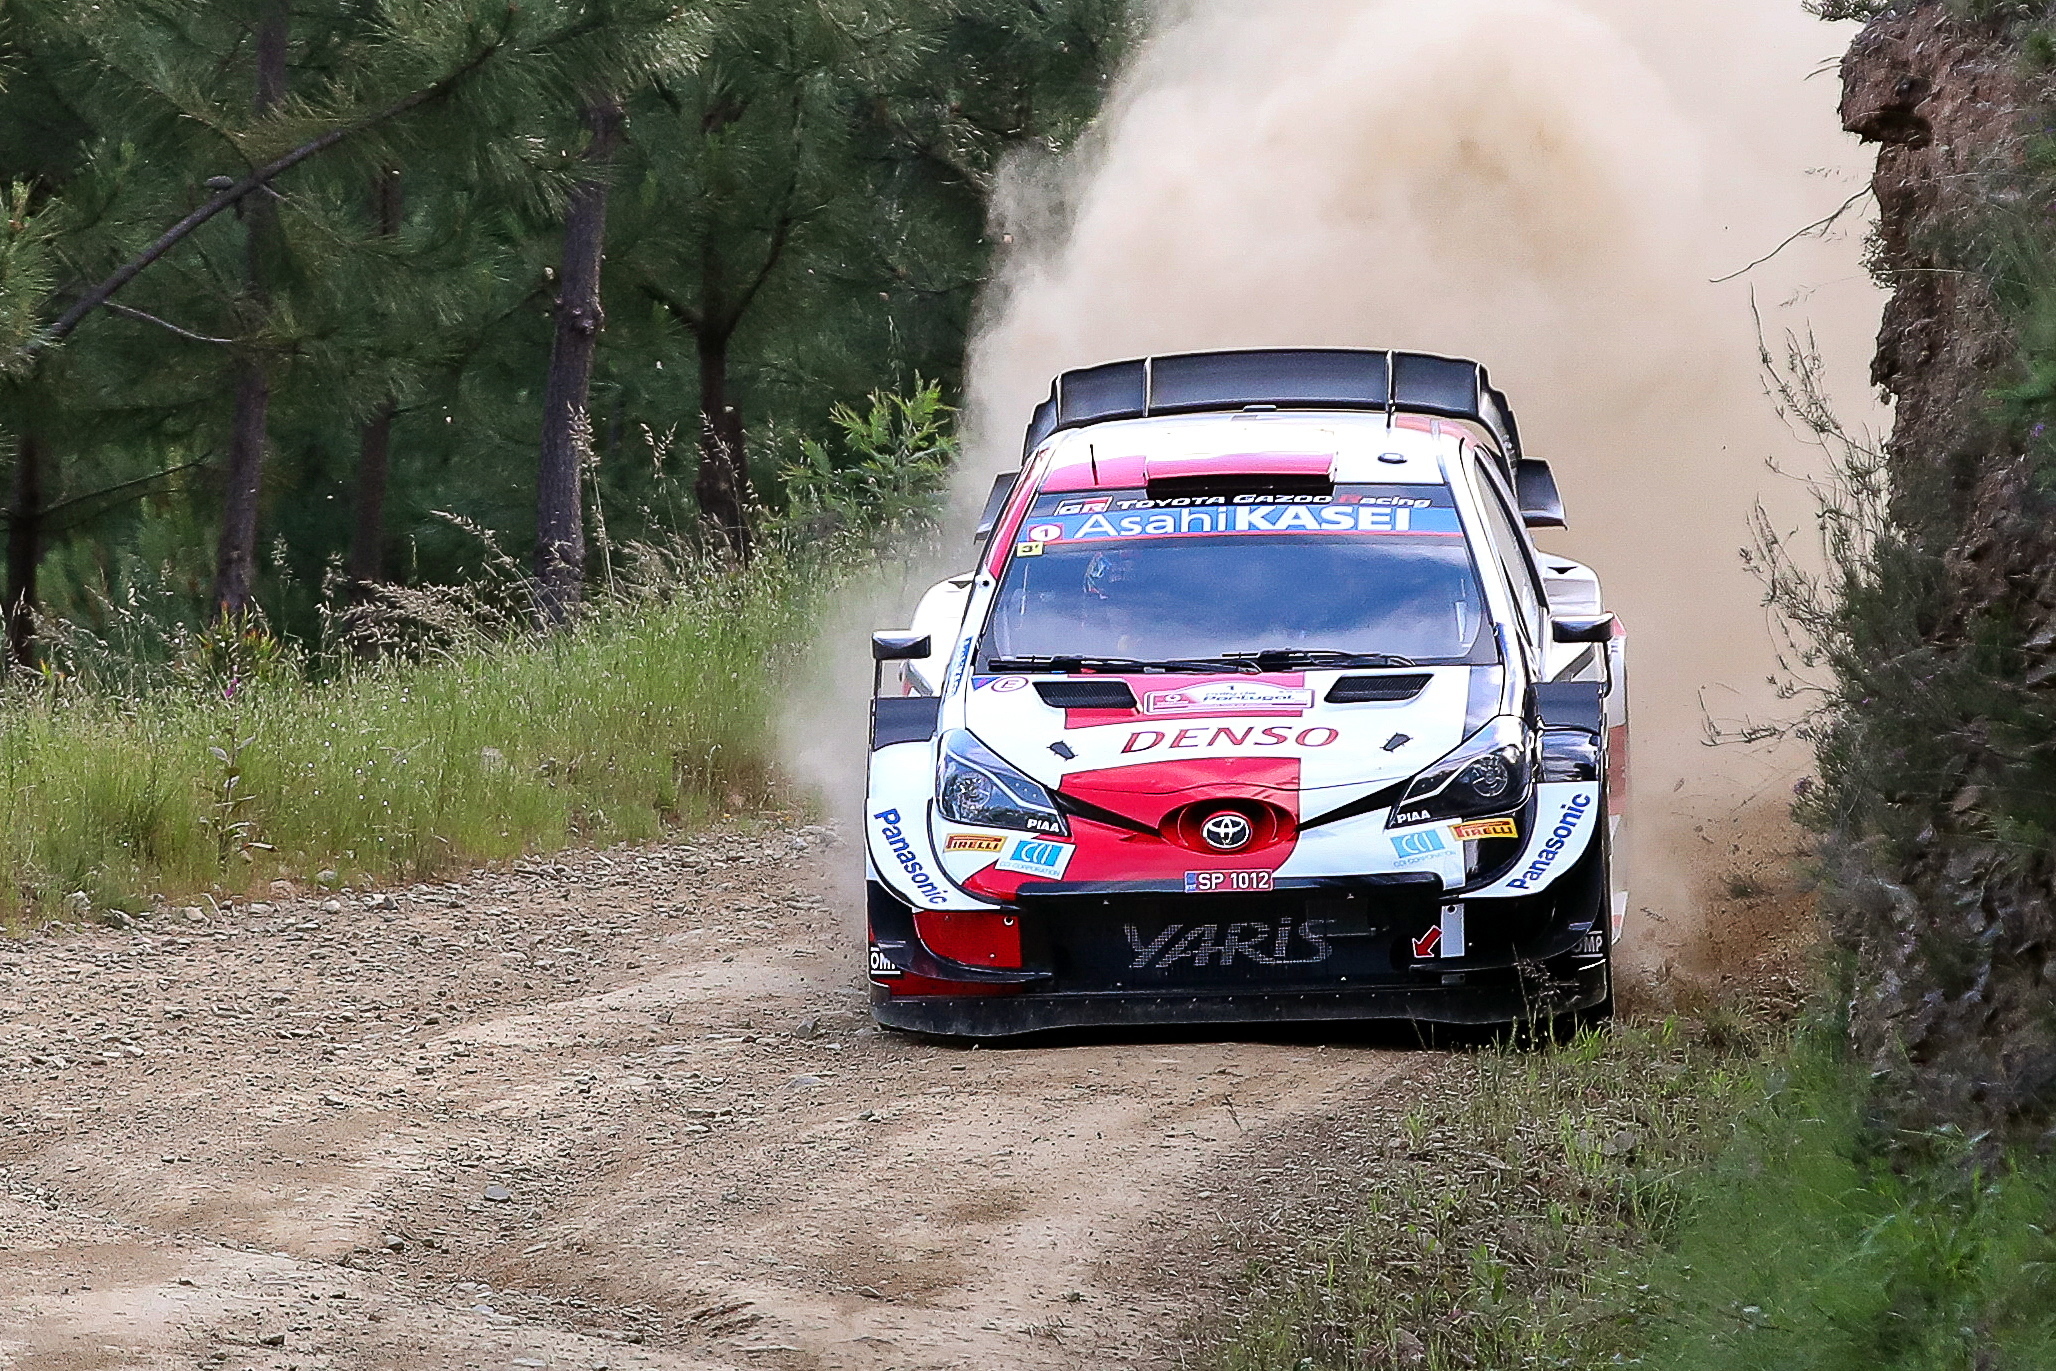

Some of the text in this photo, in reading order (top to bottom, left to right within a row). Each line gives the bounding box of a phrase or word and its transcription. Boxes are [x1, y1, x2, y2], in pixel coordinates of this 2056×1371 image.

[1116, 496, 1226, 510] TOYOTA
[1232, 494, 1335, 506] GAZOO
[1338, 494, 1432, 509] Racing
[1120, 725, 1340, 753] DENSO
[1026, 818, 1060, 833] PIAA
[1396, 810, 1432, 824] PIAA
[1455, 821, 1513, 838] PIRELLI
[946, 834, 1003, 851] PIRELLI
[1505, 792, 1592, 891] Panasonic
[873, 808, 948, 905] Panasonic
[1198, 872, 1224, 890] SP
[1230, 871, 1270, 890] 1012
[870, 951, 896, 970] OM
